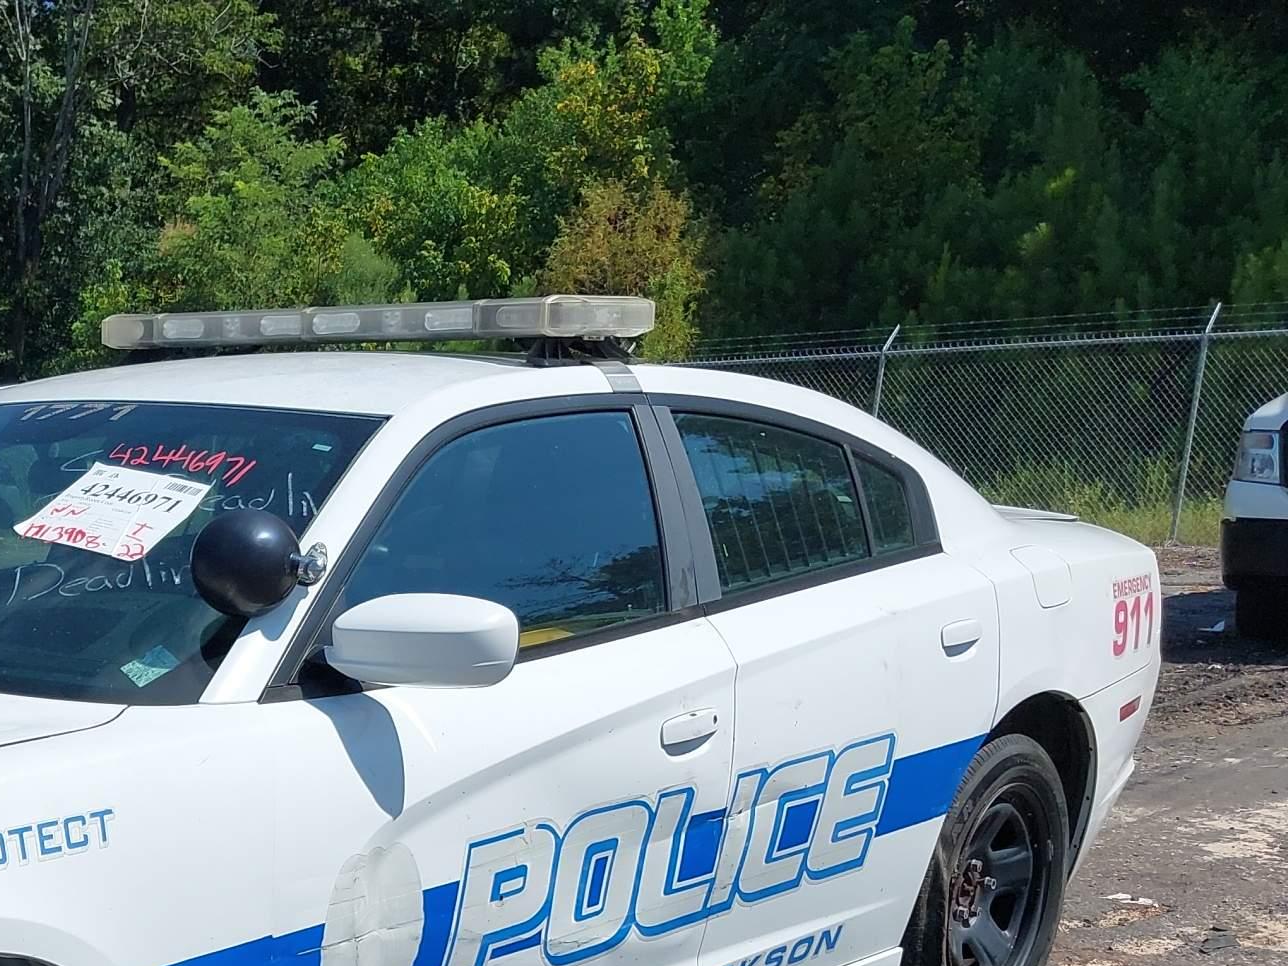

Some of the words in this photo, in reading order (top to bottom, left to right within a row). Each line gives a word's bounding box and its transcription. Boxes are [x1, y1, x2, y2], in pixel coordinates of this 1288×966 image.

[109, 443, 256, 487] 42446971
[80, 482, 183, 514] 42446971
[1112, 574, 1152, 599] EMERGENCY
[1112, 591, 1154, 657] 911
